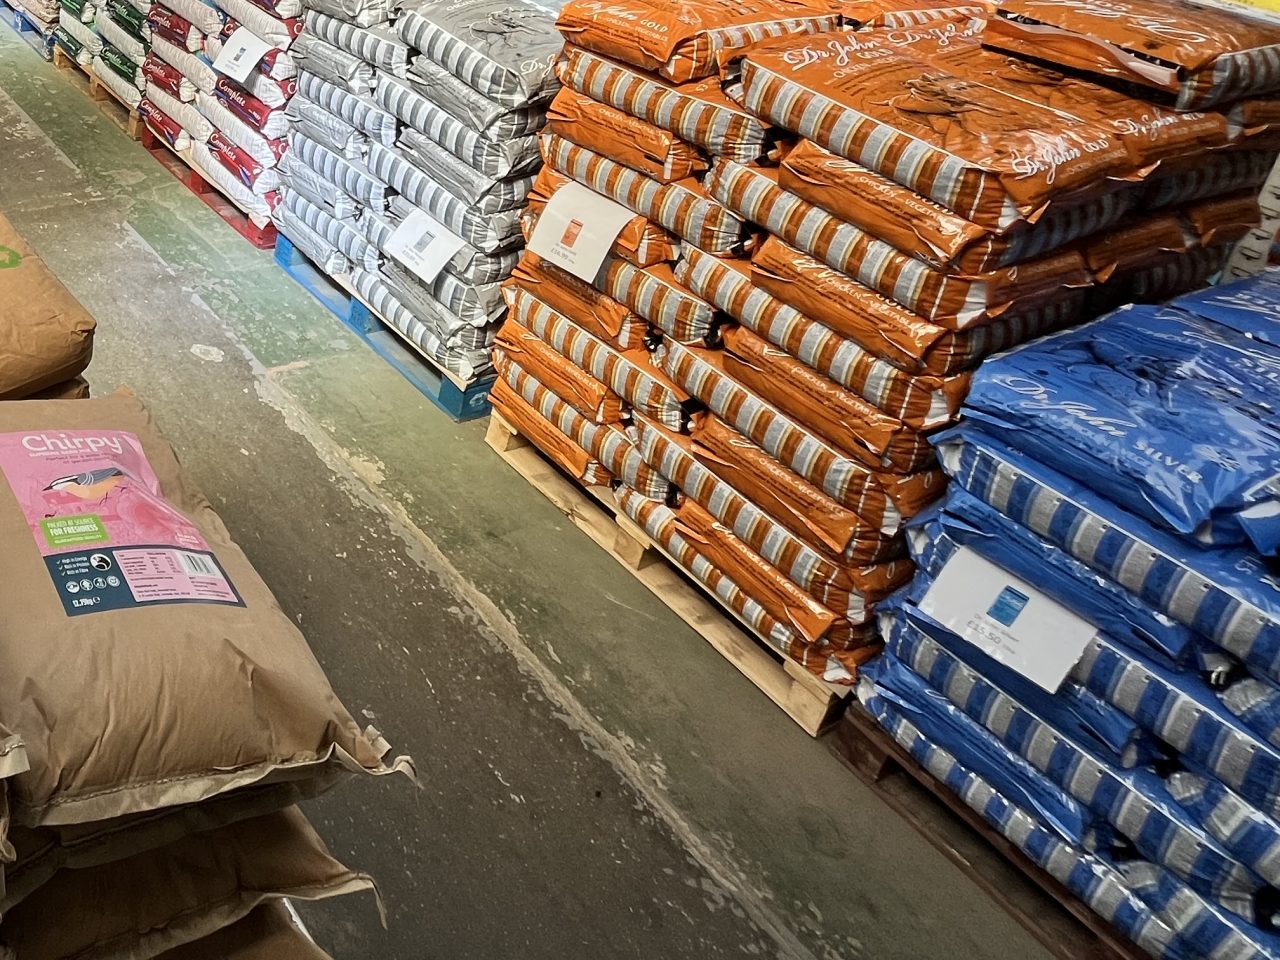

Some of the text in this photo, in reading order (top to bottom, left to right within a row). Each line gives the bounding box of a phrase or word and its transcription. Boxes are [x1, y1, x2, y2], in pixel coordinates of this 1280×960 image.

[149, 10, 171, 28] Complete
[640, 18, 669, 34] GOLD
[218, 78, 246, 107] Complete
[140, 99, 163, 123] Complete
[210, 133, 237, 161] Complete
[858, 175, 895, 198] CHICKEN
[825, 273, 863, 300] CHICKEN
[21, 433, 123, 455] Chirpy
[1132, 439, 1204, 483] SILVER
[50, 523, 98, 536] FOR FRESHNESS
[966, 619, 1002, 645] £15.50
